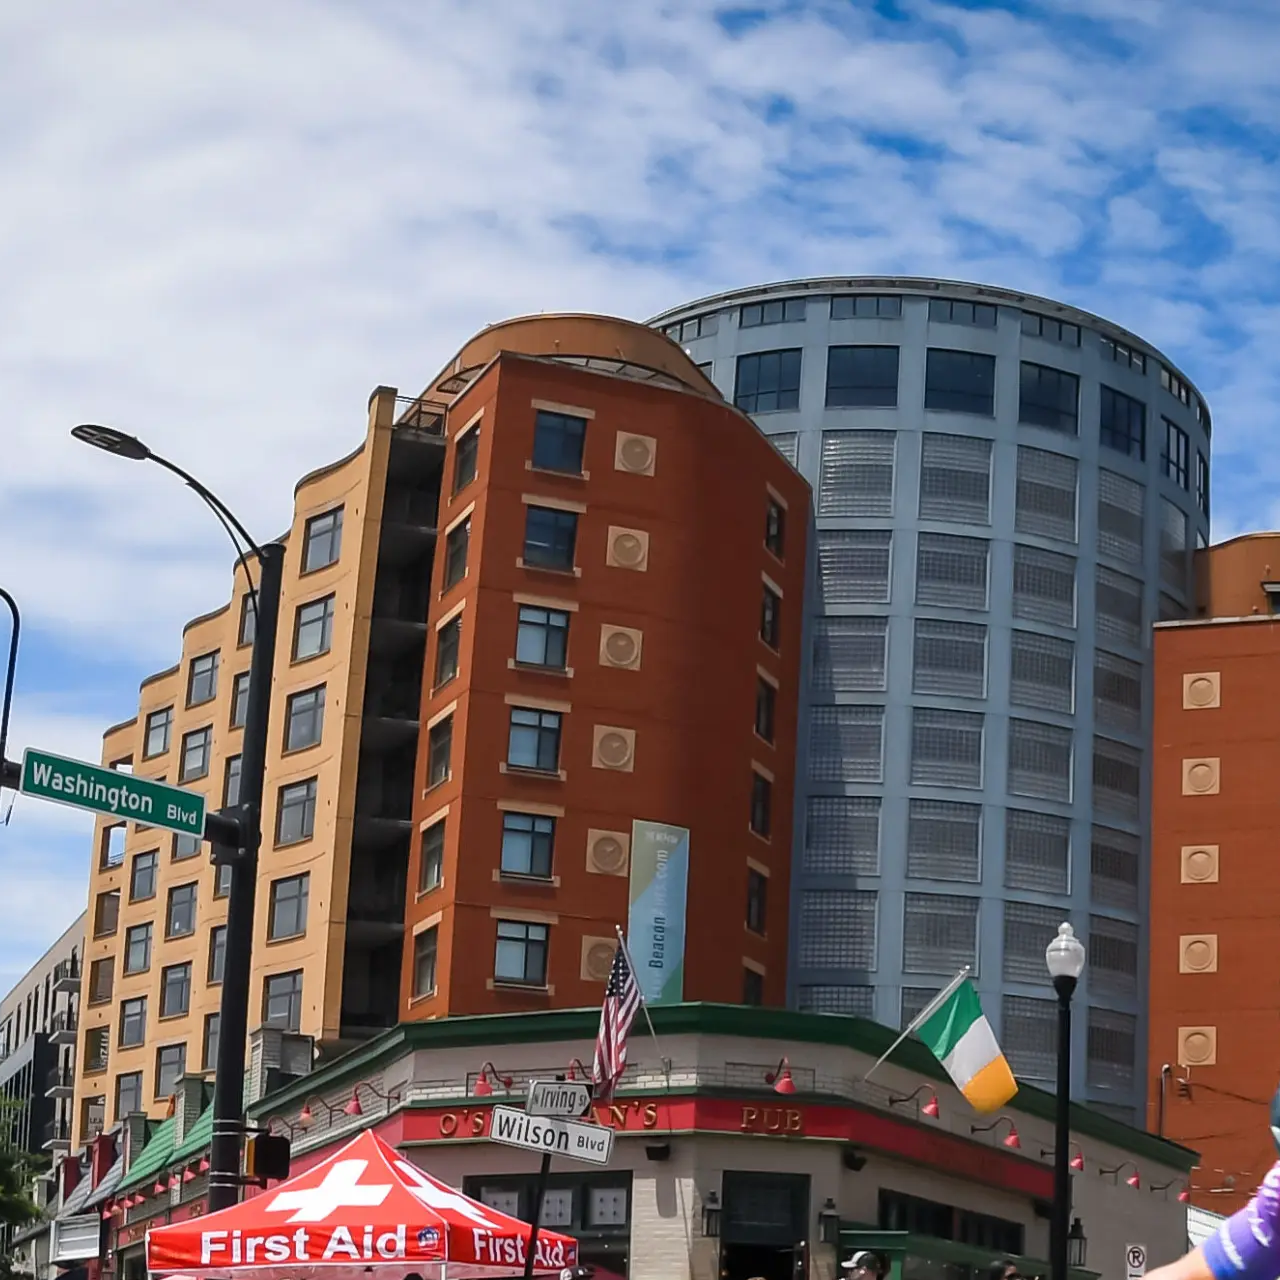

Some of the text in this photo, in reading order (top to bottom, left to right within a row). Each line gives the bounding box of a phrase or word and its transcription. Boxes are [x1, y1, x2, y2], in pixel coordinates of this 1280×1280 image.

[33, 761, 197, 825] Washington Blvd
[540, 1086, 577, 1114] Irving
[740, 1106, 802, 1131] PUB
[498, 1114, 605, 1152] Wilson Blvd
[200, 1229, 310, 1264] First
[321, 1224, 407, 1261] Aid
[473, 1227, 526, 1264] First
[534, 1239, 565, 1267] Aid
